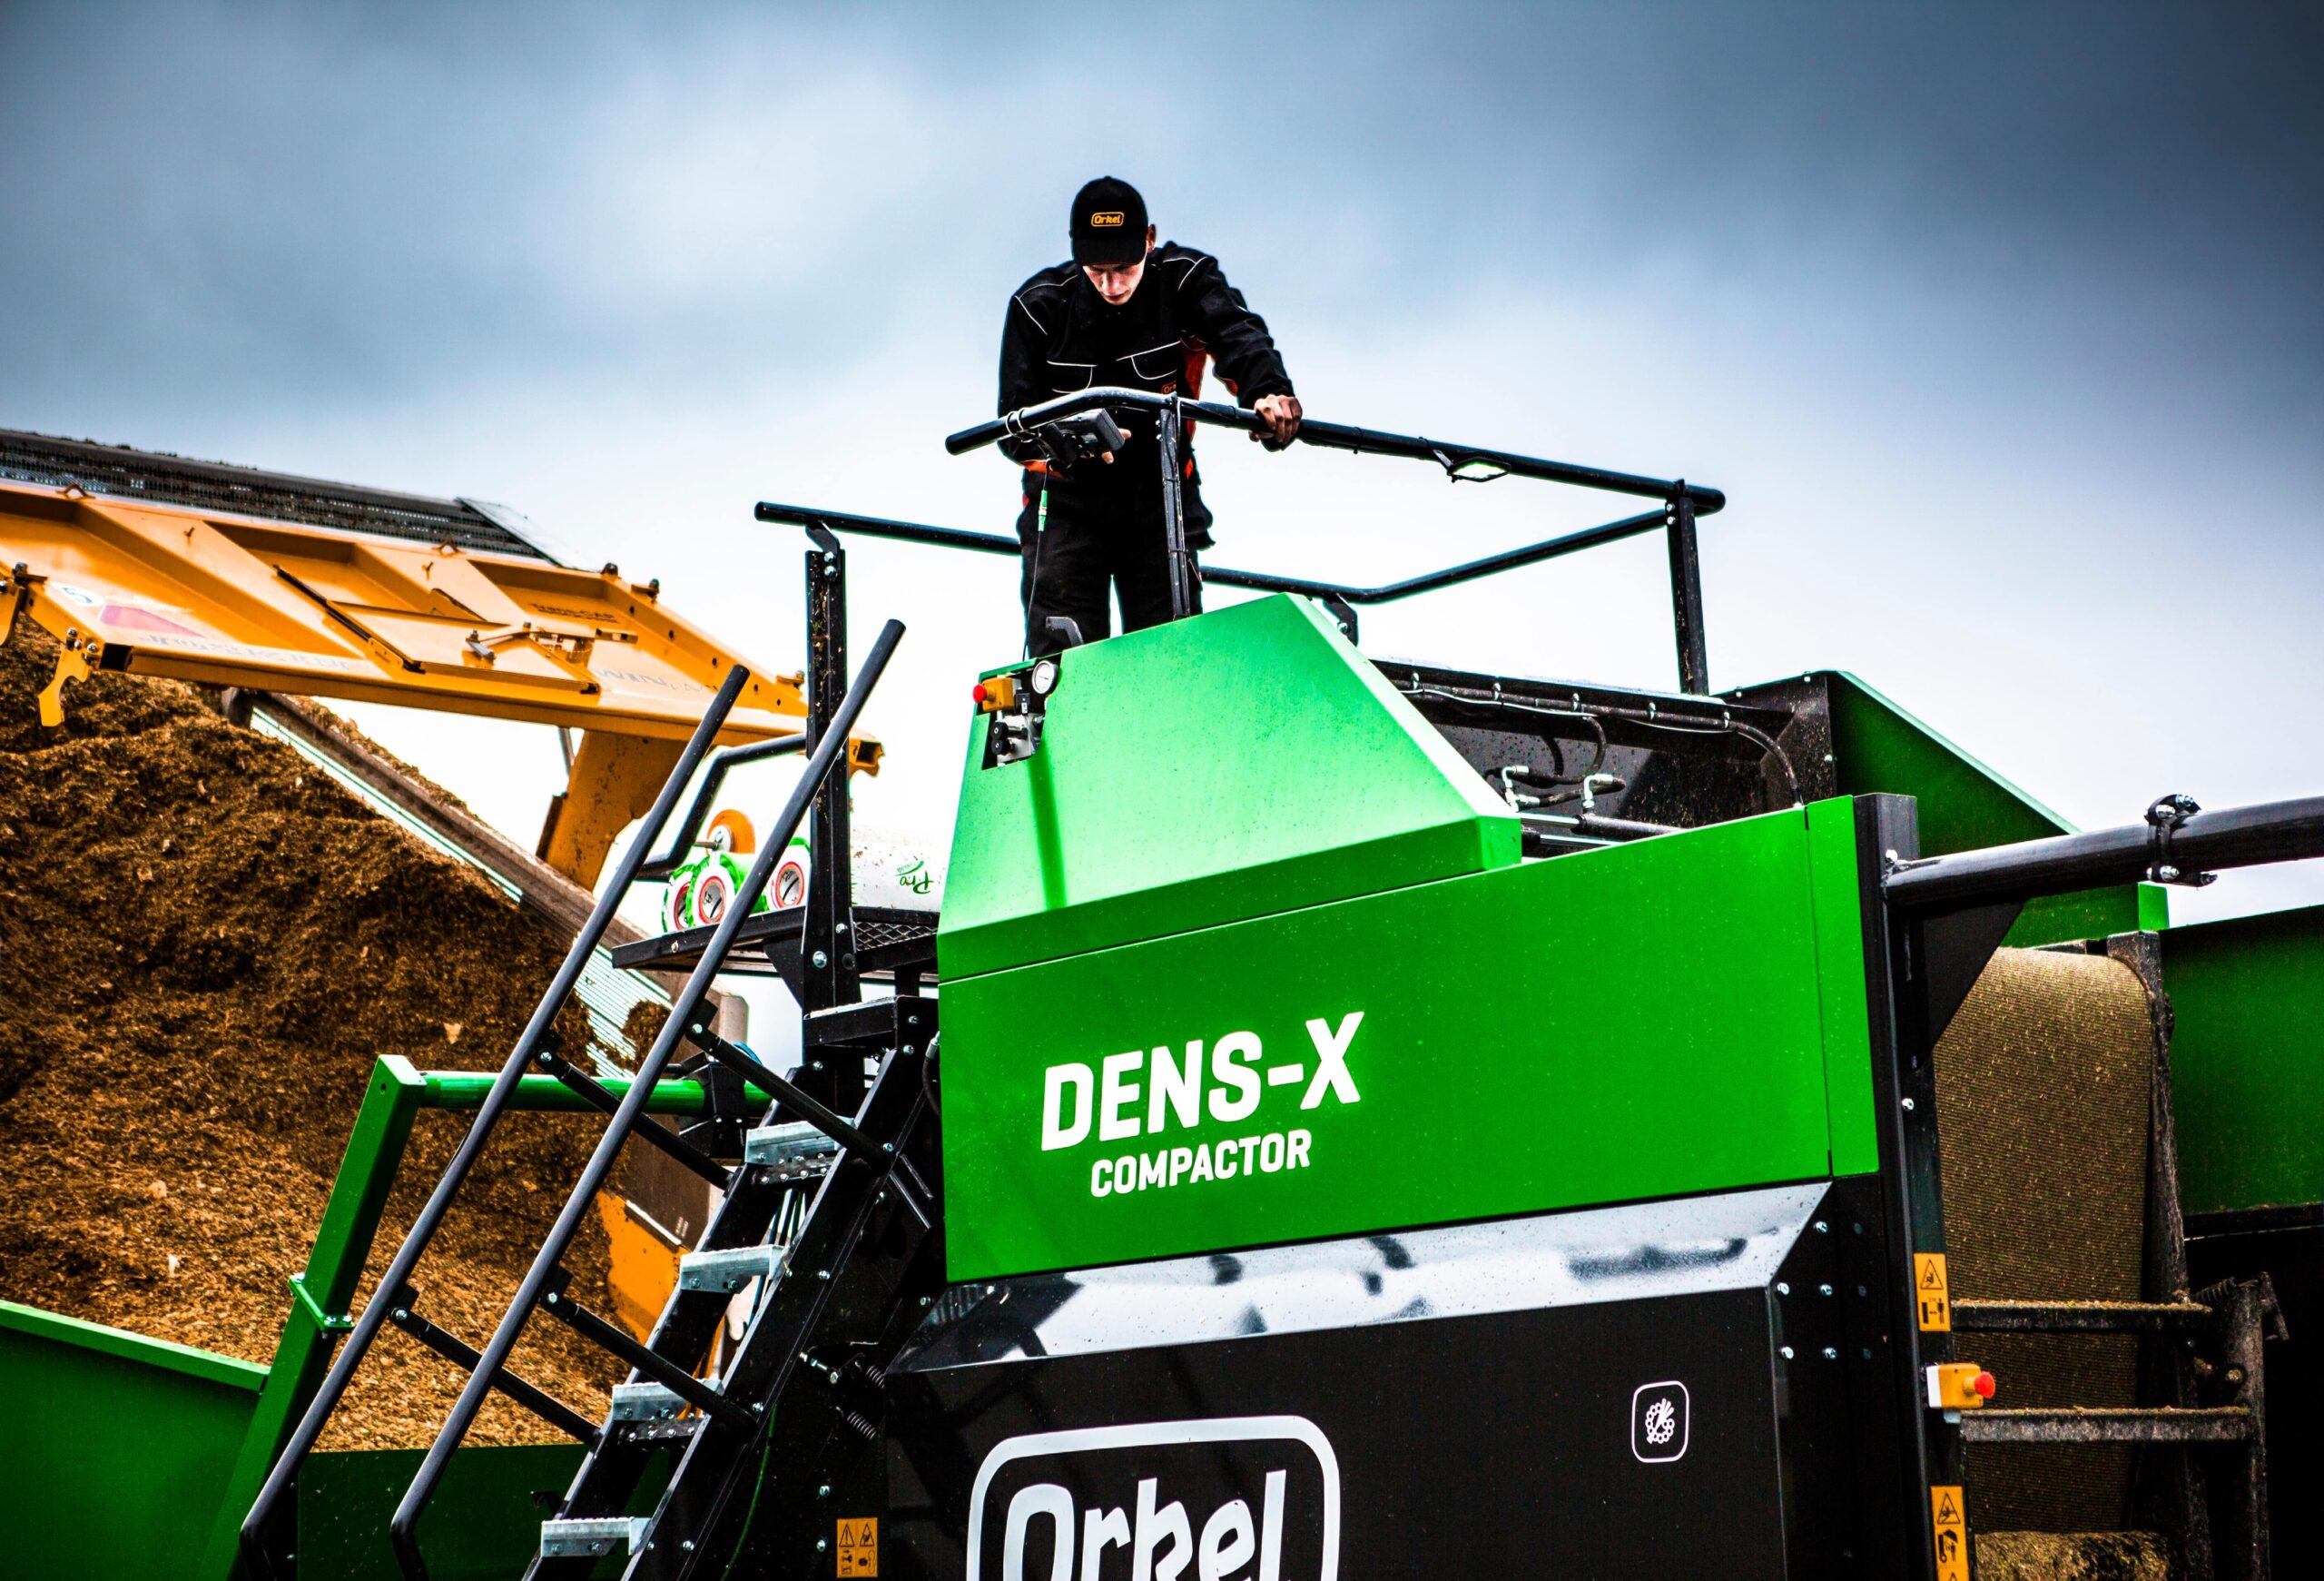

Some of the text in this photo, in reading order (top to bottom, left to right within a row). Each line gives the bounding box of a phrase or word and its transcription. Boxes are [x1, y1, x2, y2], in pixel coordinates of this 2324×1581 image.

[1093, 213, 1122, 225] Orkel
[899, 870, 935, 895] Pro
[1041, 1011, 1364, 1151] DENS-X
[1090, 1128, 1312, 1198] COMPACTOR
[1003, 1468, 1291, 1581] Orkel
